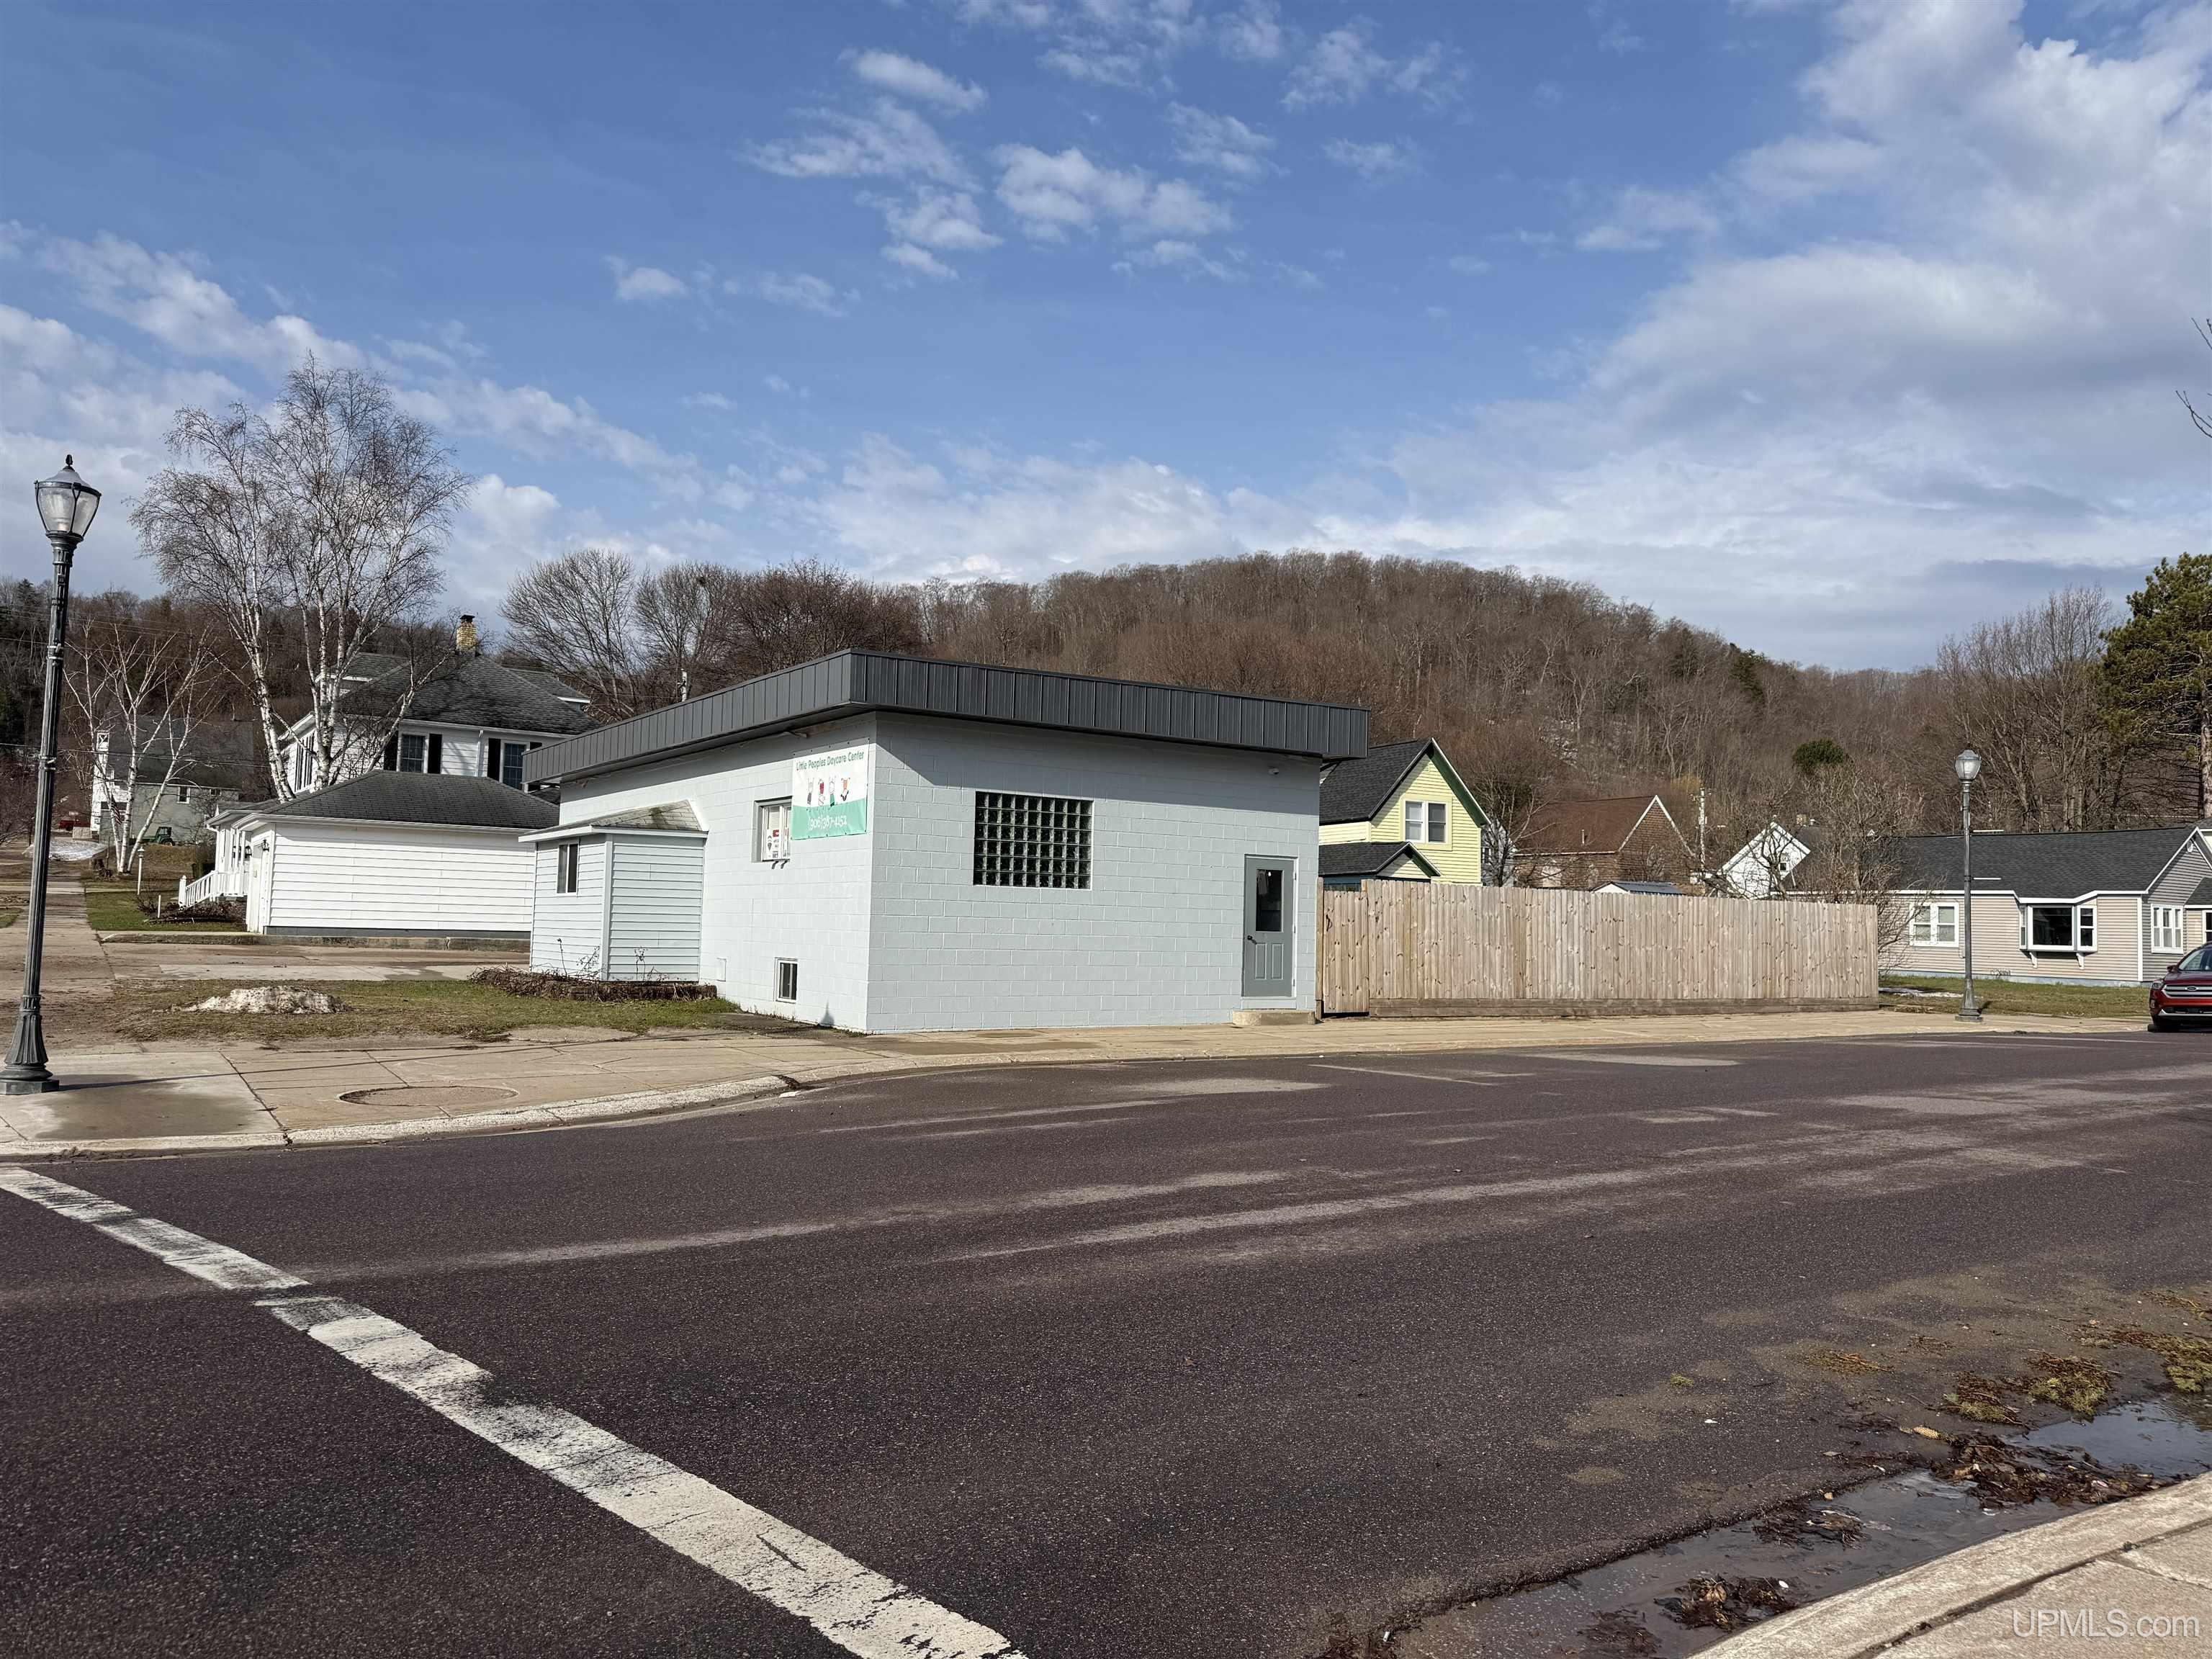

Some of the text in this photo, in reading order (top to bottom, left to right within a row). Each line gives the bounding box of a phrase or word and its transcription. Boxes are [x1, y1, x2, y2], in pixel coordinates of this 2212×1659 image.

[796, 751, 864, 770] Little Peoples Daycare Center
